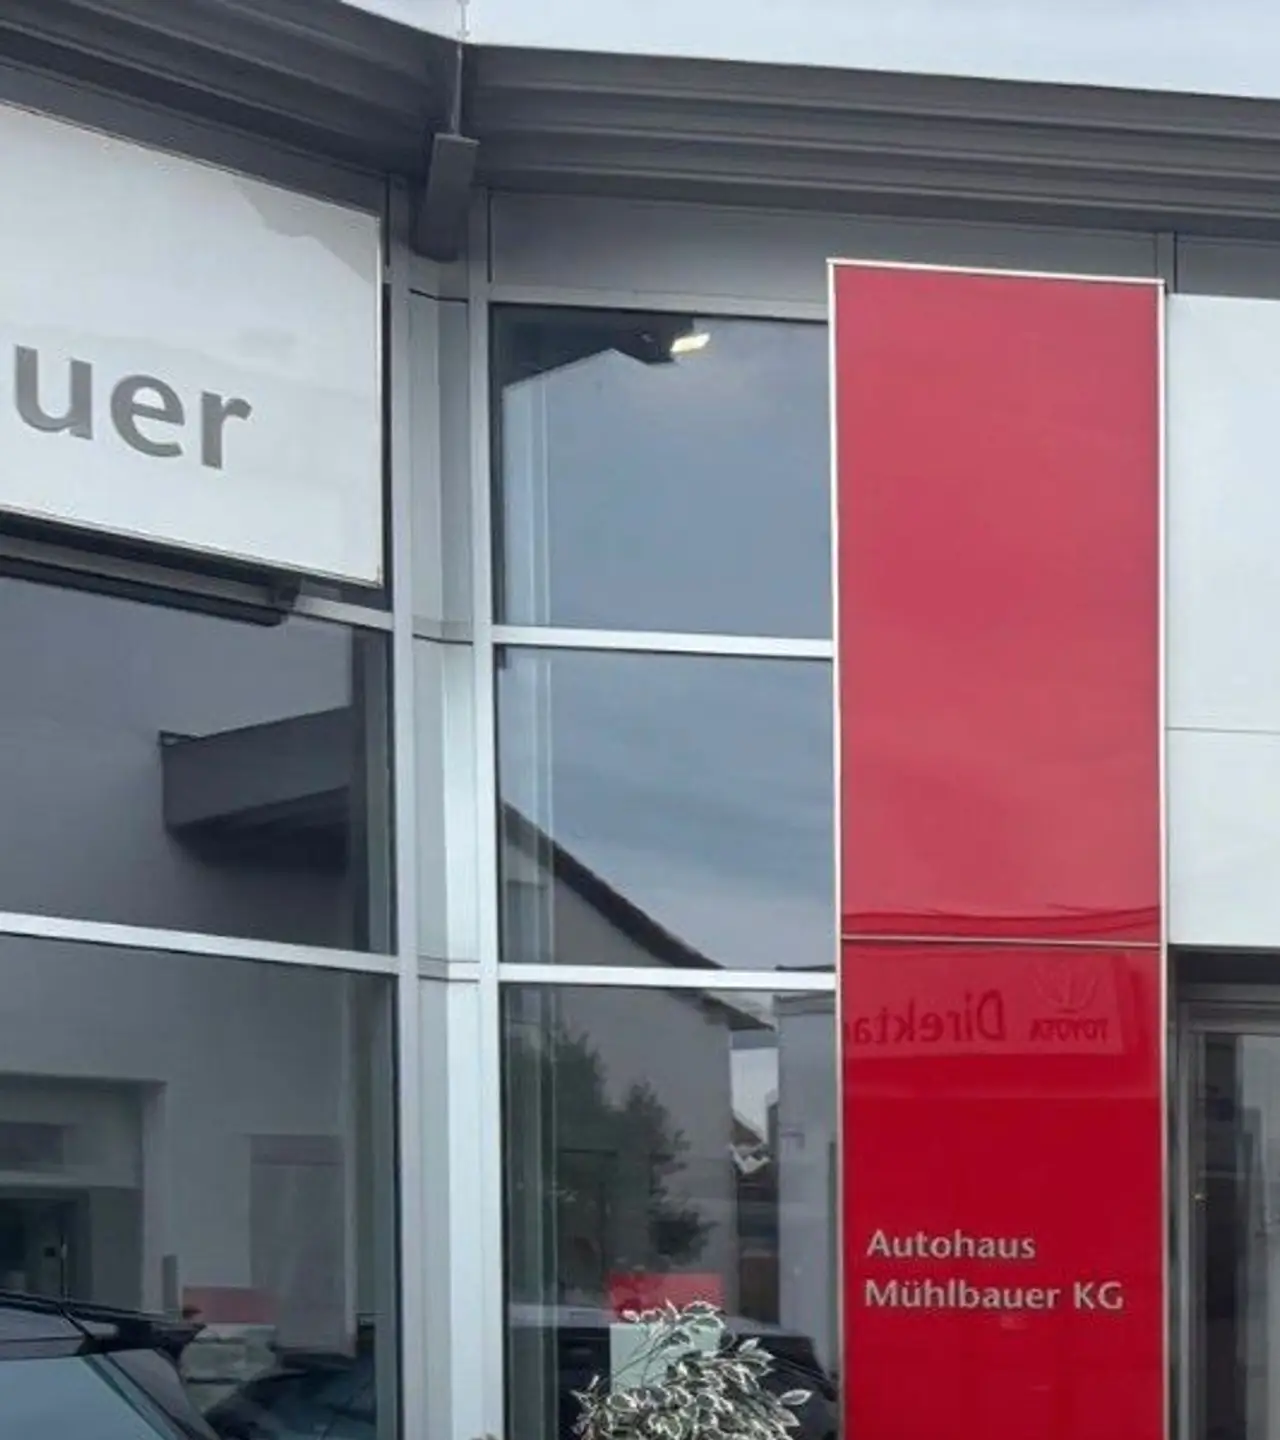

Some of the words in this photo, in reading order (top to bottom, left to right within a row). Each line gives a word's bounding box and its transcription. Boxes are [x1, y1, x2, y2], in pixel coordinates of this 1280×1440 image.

[14, 343, 252, 470] uer
[865, 1228, 1037, 1260] Autohaus
[864, 1278, 1060, 1310] Mühlbauer
[1073, 1280, 1125, 1310] KG
